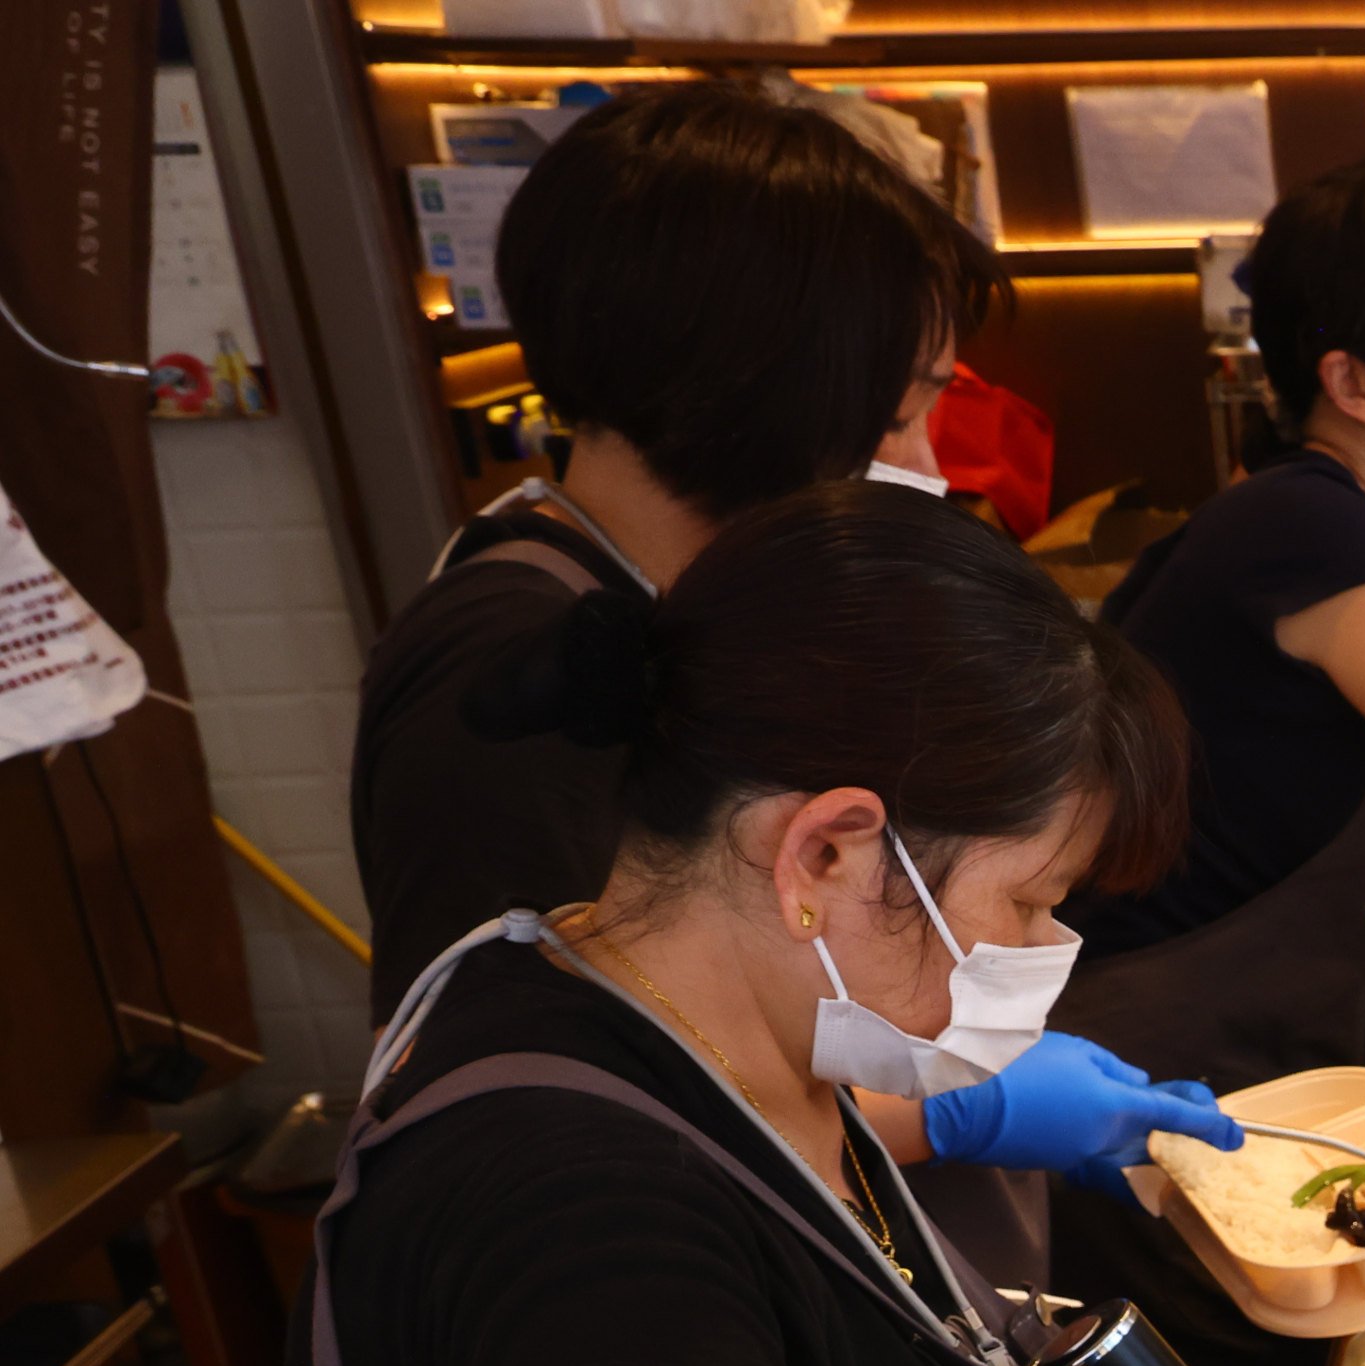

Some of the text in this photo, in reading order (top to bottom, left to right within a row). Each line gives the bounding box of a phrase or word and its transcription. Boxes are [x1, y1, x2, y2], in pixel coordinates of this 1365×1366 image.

[57, 70, 78, 144] LIFE
[79, 107, 102, 175] NOT
[77, 189, 101, 279] EASY
